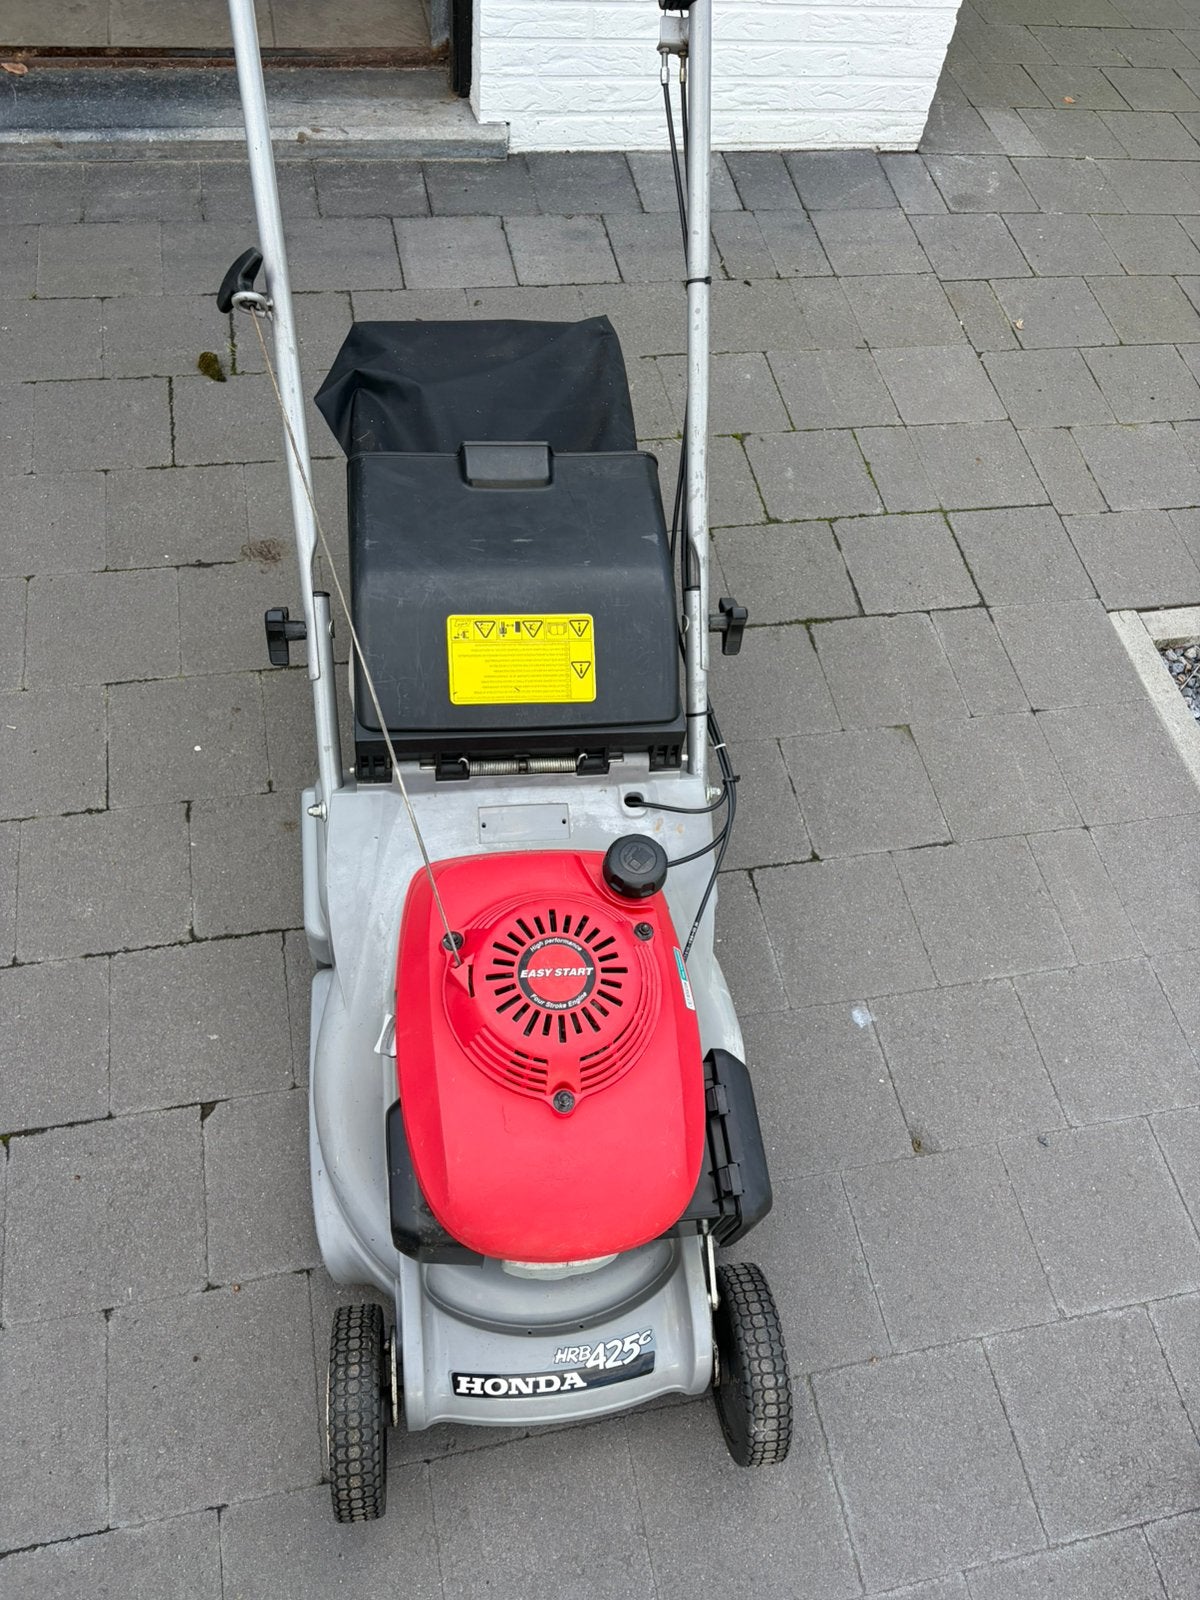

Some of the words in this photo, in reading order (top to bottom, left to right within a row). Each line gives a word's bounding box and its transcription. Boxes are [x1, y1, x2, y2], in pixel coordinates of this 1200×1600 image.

[530, 941, 544, 952] High
[544, 938, 582, 951] performance
[520, 968, 553, 978] EASY
[554, 967, 593, 976] START
[530, 993, 545, 1005] Four
[545, 1001, 567, 1009] Stroke
[568, 992, 587, 1007] Engine
[456, 1372, 587, 1396] HONDA
